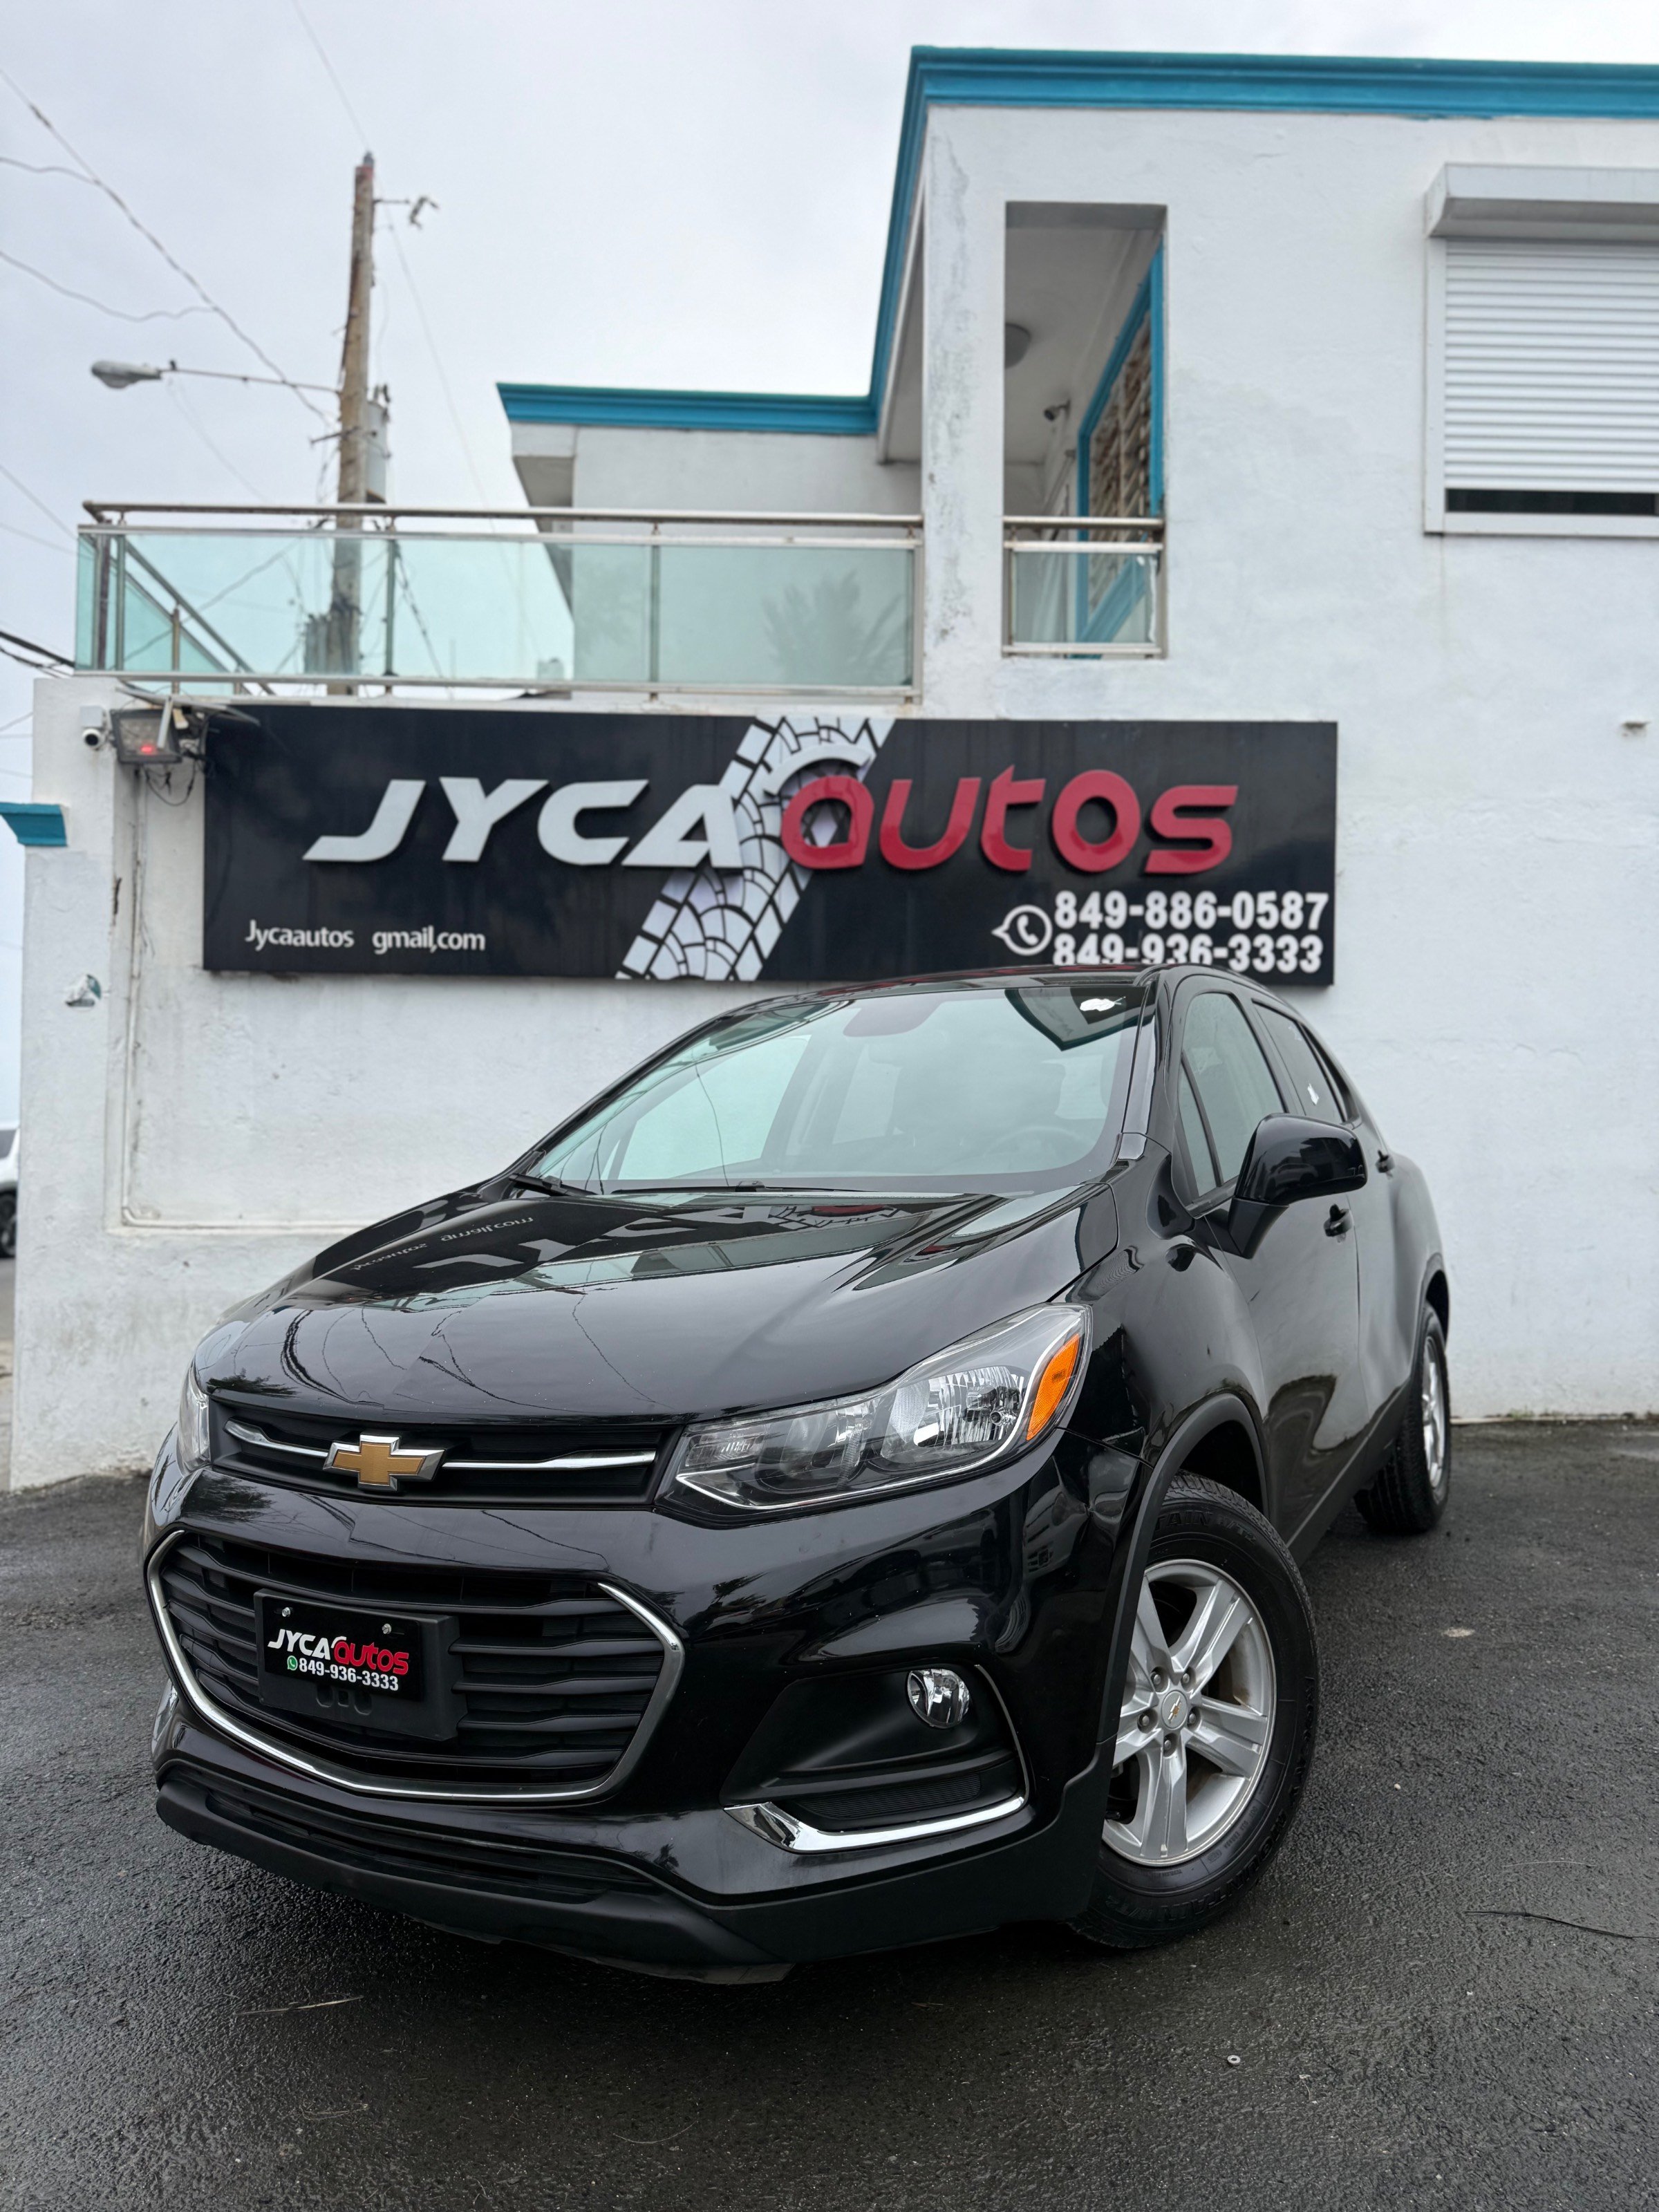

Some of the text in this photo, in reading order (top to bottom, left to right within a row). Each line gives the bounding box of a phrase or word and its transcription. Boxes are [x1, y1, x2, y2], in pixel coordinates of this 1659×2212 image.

[302, 776, 744, 869] JYCA
[1054, 890, 1329, 930] 849-886-0587
[245, 919, 355, 952] Jycaautos
[1052, 933, 1324, 973] 849-936-3333
[267, 1628, 331, 1660] JYCA
[298, 1657, 399, 1691] 849-936-3333
